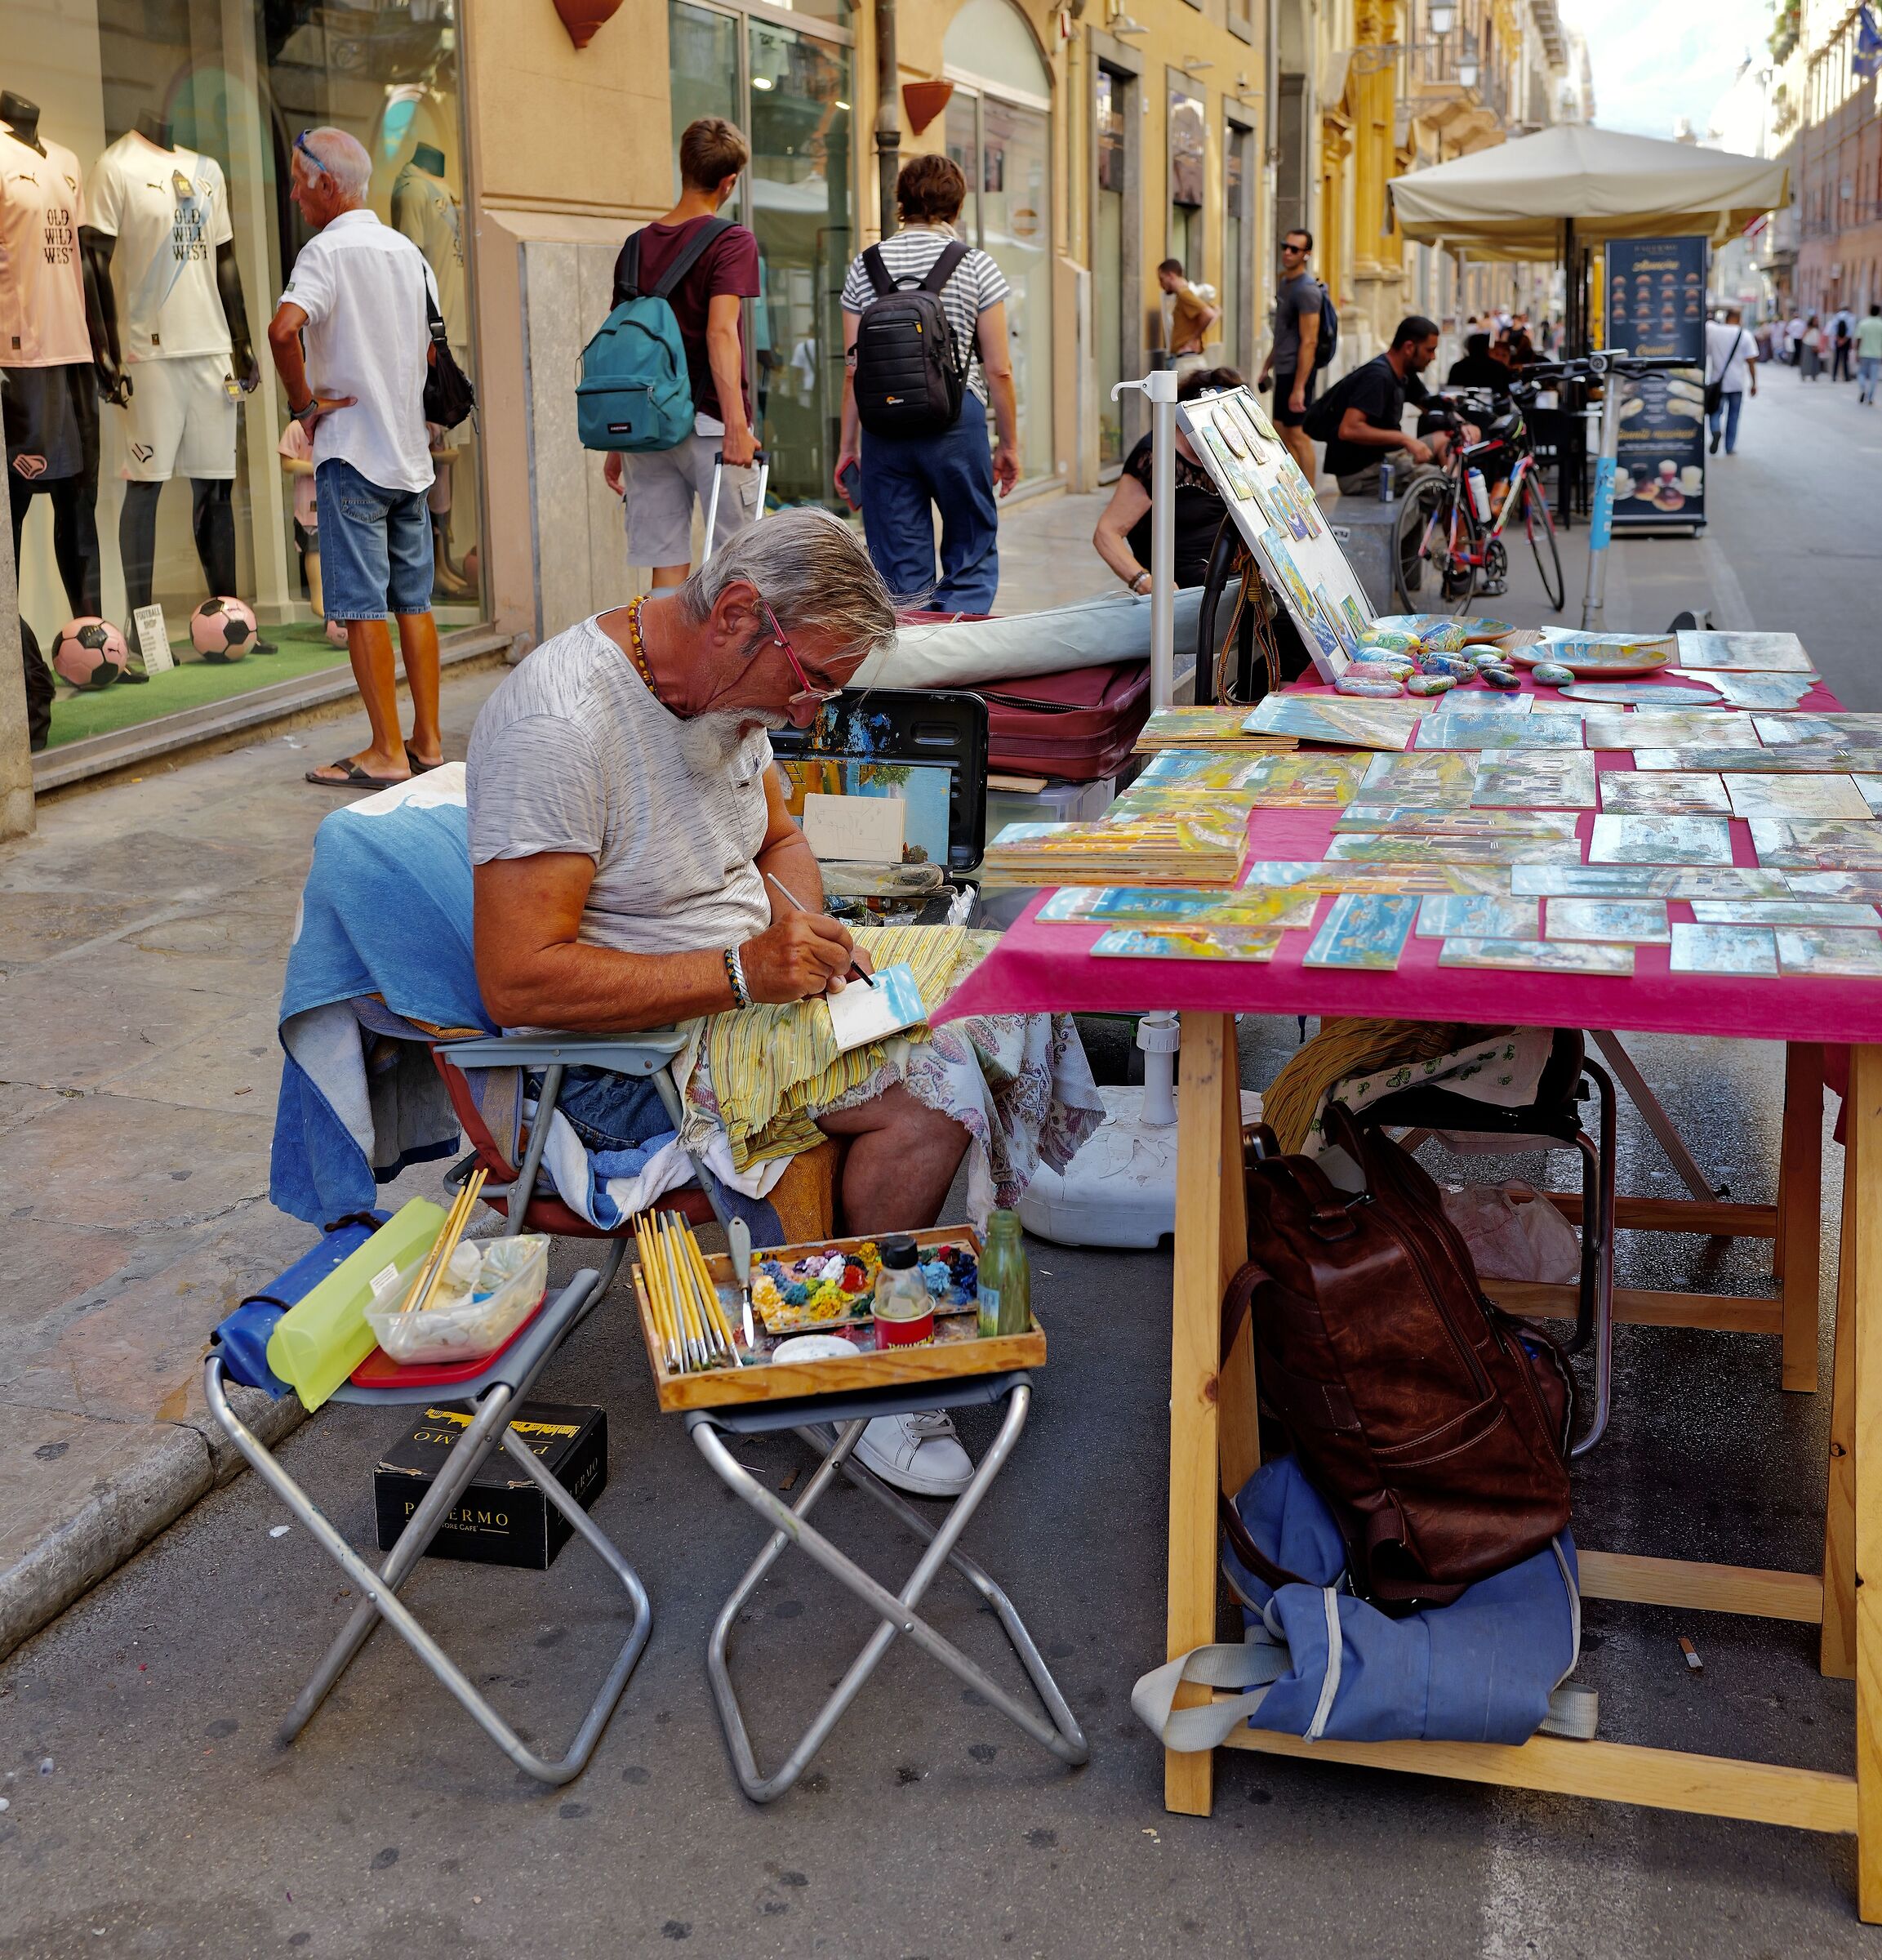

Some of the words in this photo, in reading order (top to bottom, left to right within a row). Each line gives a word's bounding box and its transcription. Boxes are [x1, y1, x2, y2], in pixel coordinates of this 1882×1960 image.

[47, 209, 69, 226] OLD
[174, 208, 201, 225] OLD
[45, 229, 73, 245] WILD
[405, 1502, 509, 1526] PERMO
